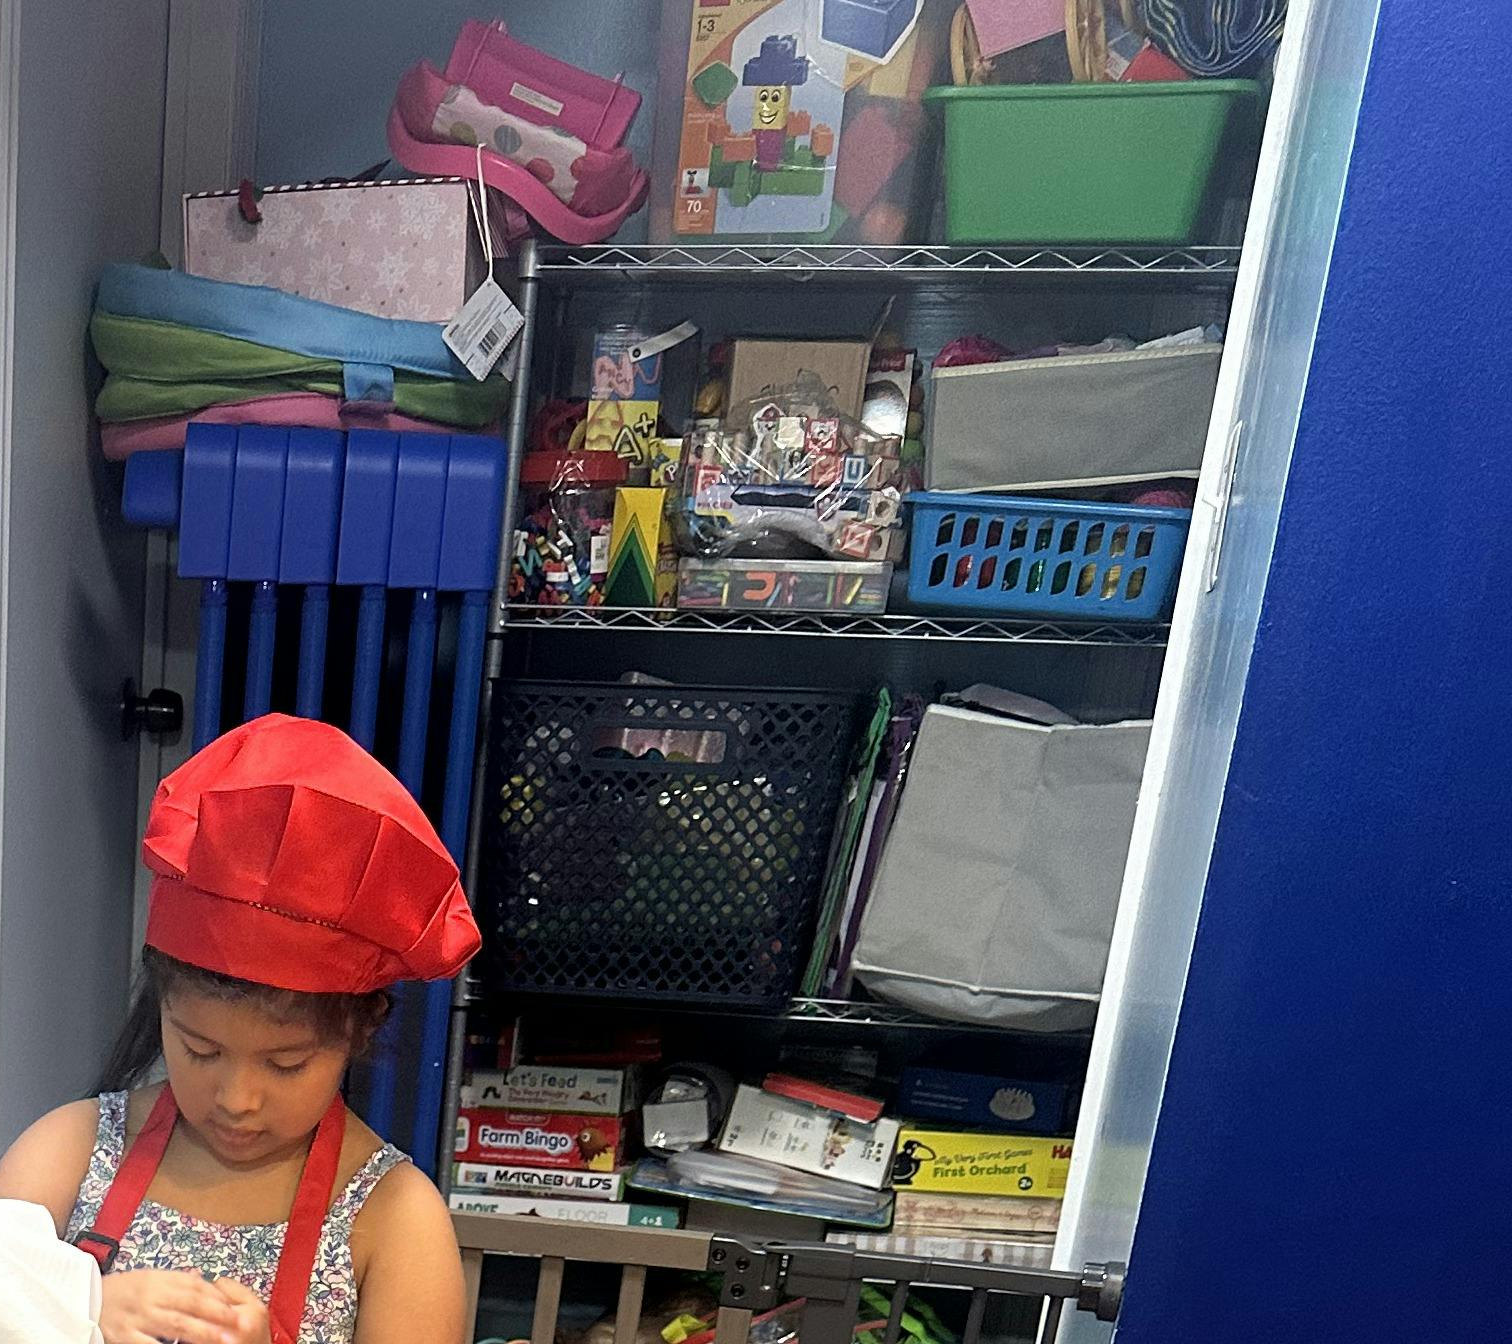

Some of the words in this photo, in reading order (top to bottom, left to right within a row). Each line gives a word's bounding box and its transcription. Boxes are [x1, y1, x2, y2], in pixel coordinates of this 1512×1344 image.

[697, 18, 715, 33] 1-3
[687, 200, 702, 213] 70
[480, 1128, 520, 1143] Farm
[524, 1131, 569, 1150] Bingo
[933, 1165, 966, 1178] First
[969, 1163, 1027, 1176] Orchard
[493, 1169, 613, 1191] MAGNEBUILDS
